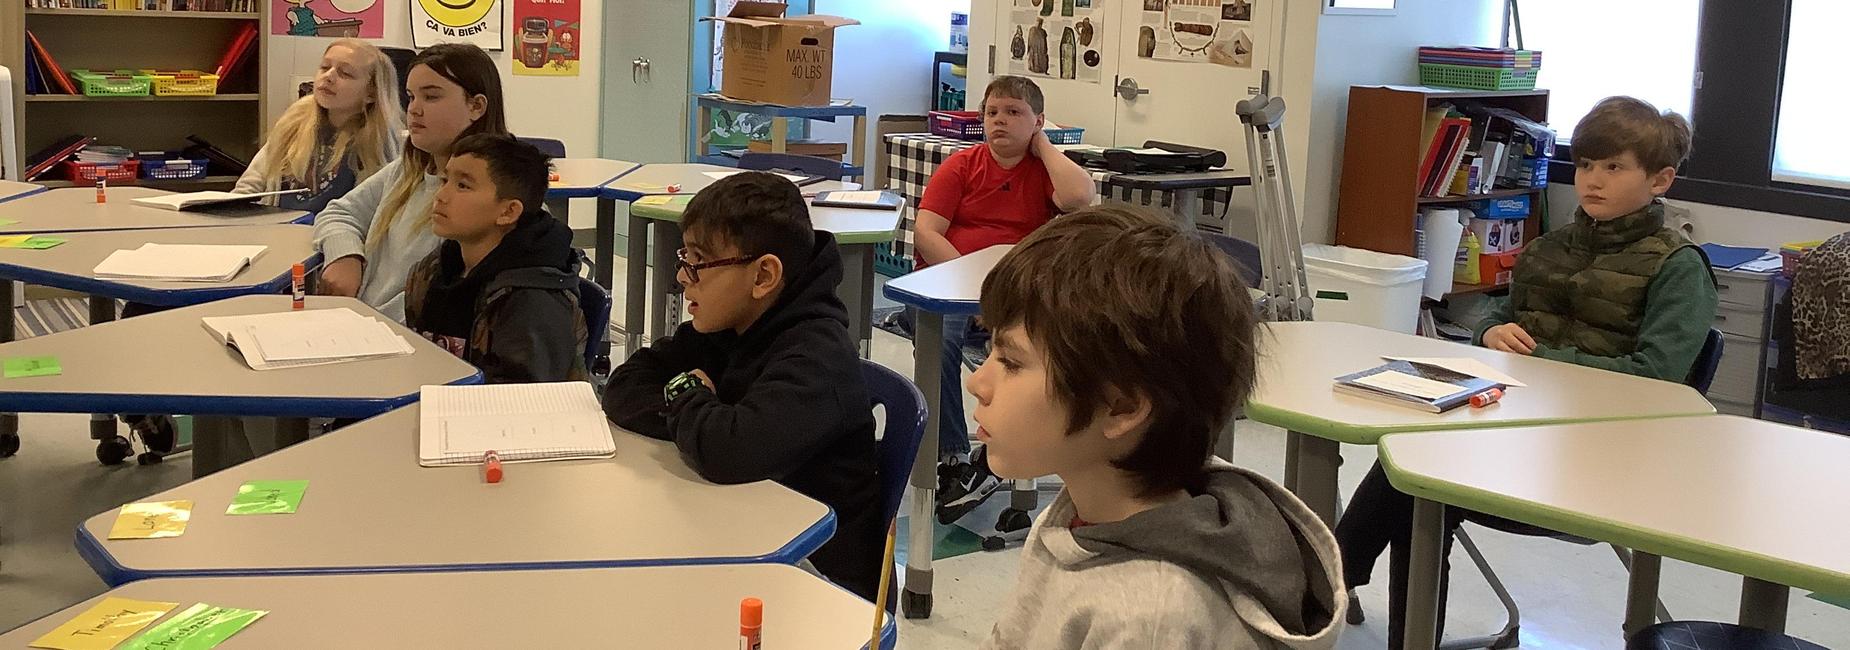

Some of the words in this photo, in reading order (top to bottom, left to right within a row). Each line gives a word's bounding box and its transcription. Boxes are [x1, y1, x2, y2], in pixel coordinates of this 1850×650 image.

[443, 26, 456, 37] VA
[458, 21, 488, 37] BIEN?
[786, 48, 808, 63] MAX.
[812, 49, 826, 63] WT
[791, 65, 803, 79] 40
[805, 65, 822, 79] LBS
